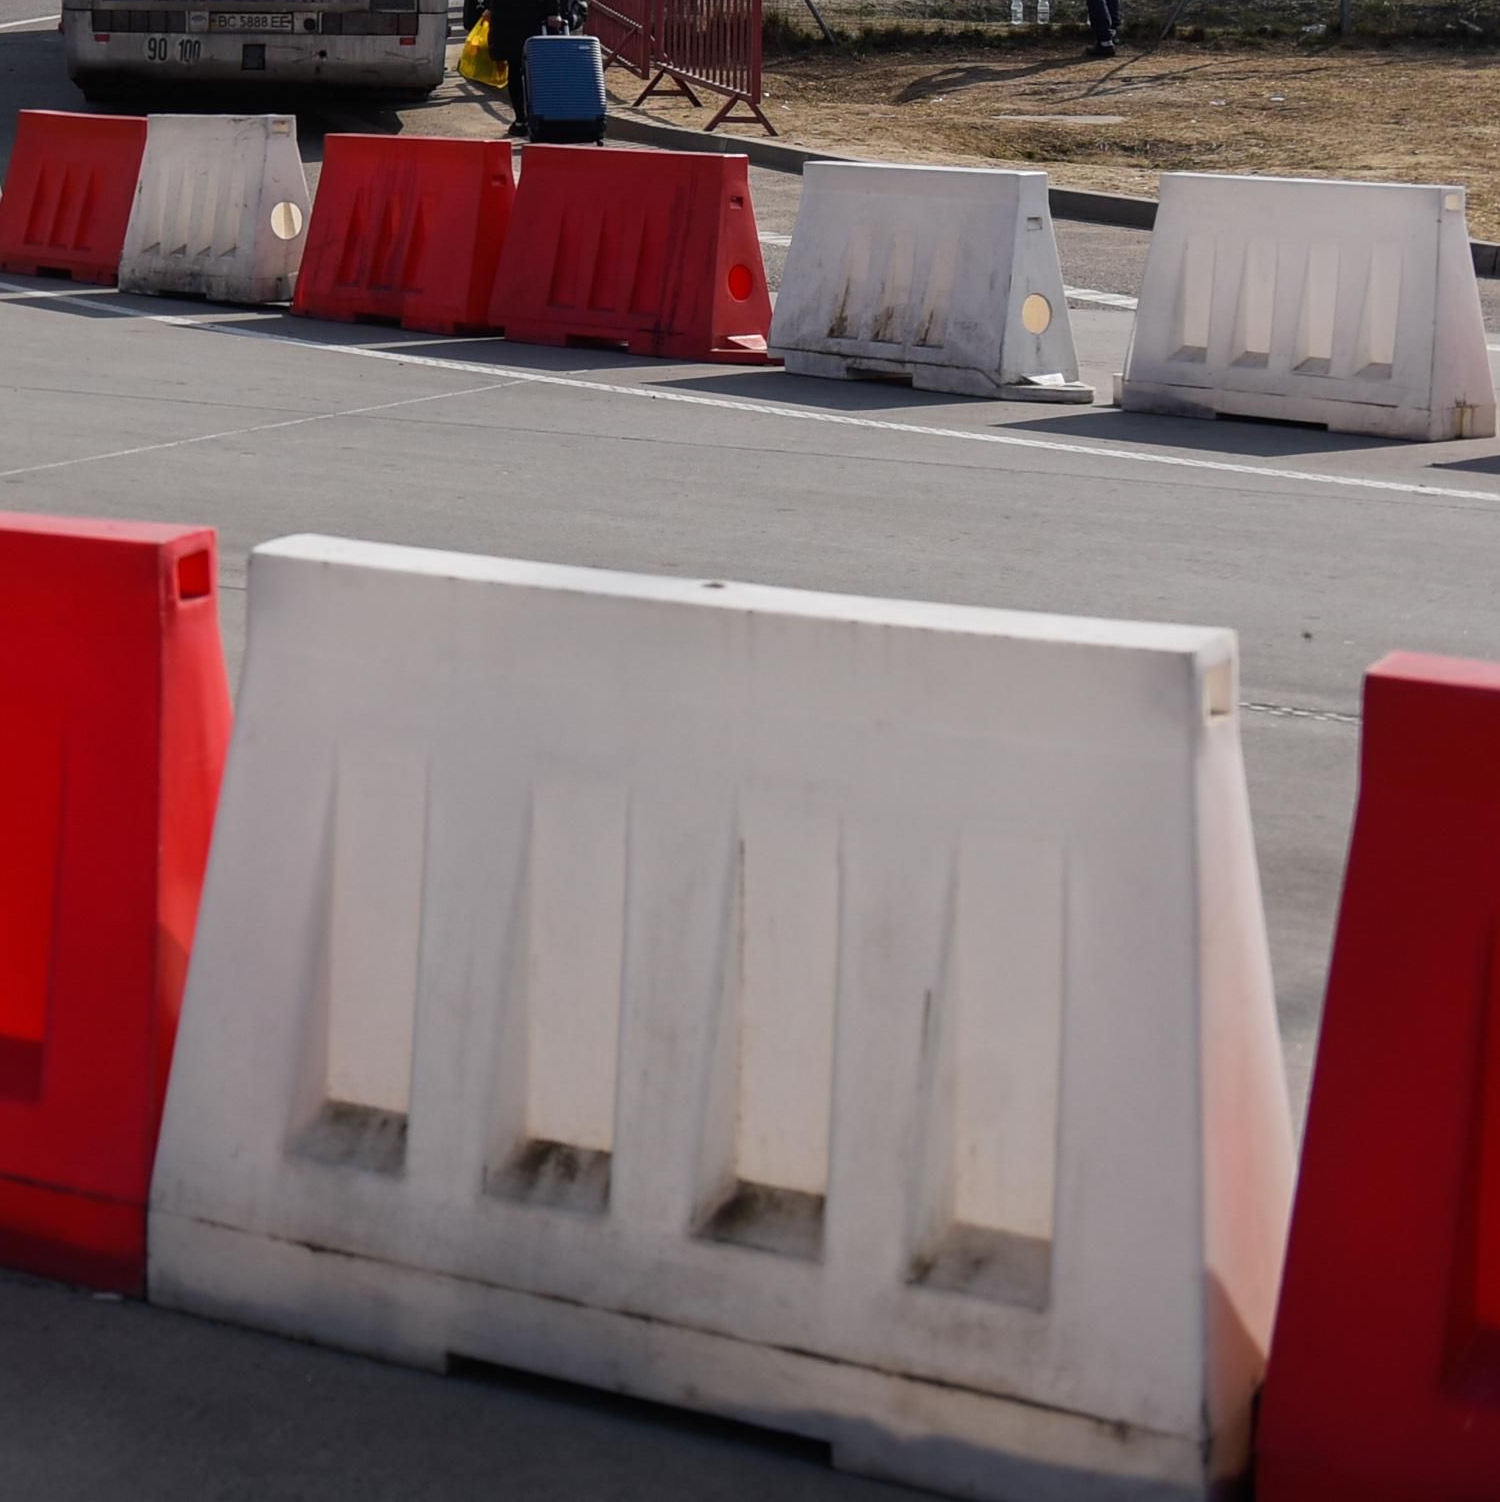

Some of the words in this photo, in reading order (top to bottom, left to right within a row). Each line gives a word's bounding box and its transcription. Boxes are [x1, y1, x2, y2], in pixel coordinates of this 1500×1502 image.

[218, 15, 236, 28] BC
[240, 15, 268, 28] 5888
[148, 37, 168, 61] 90
[178, 39, 201, 62] 100
